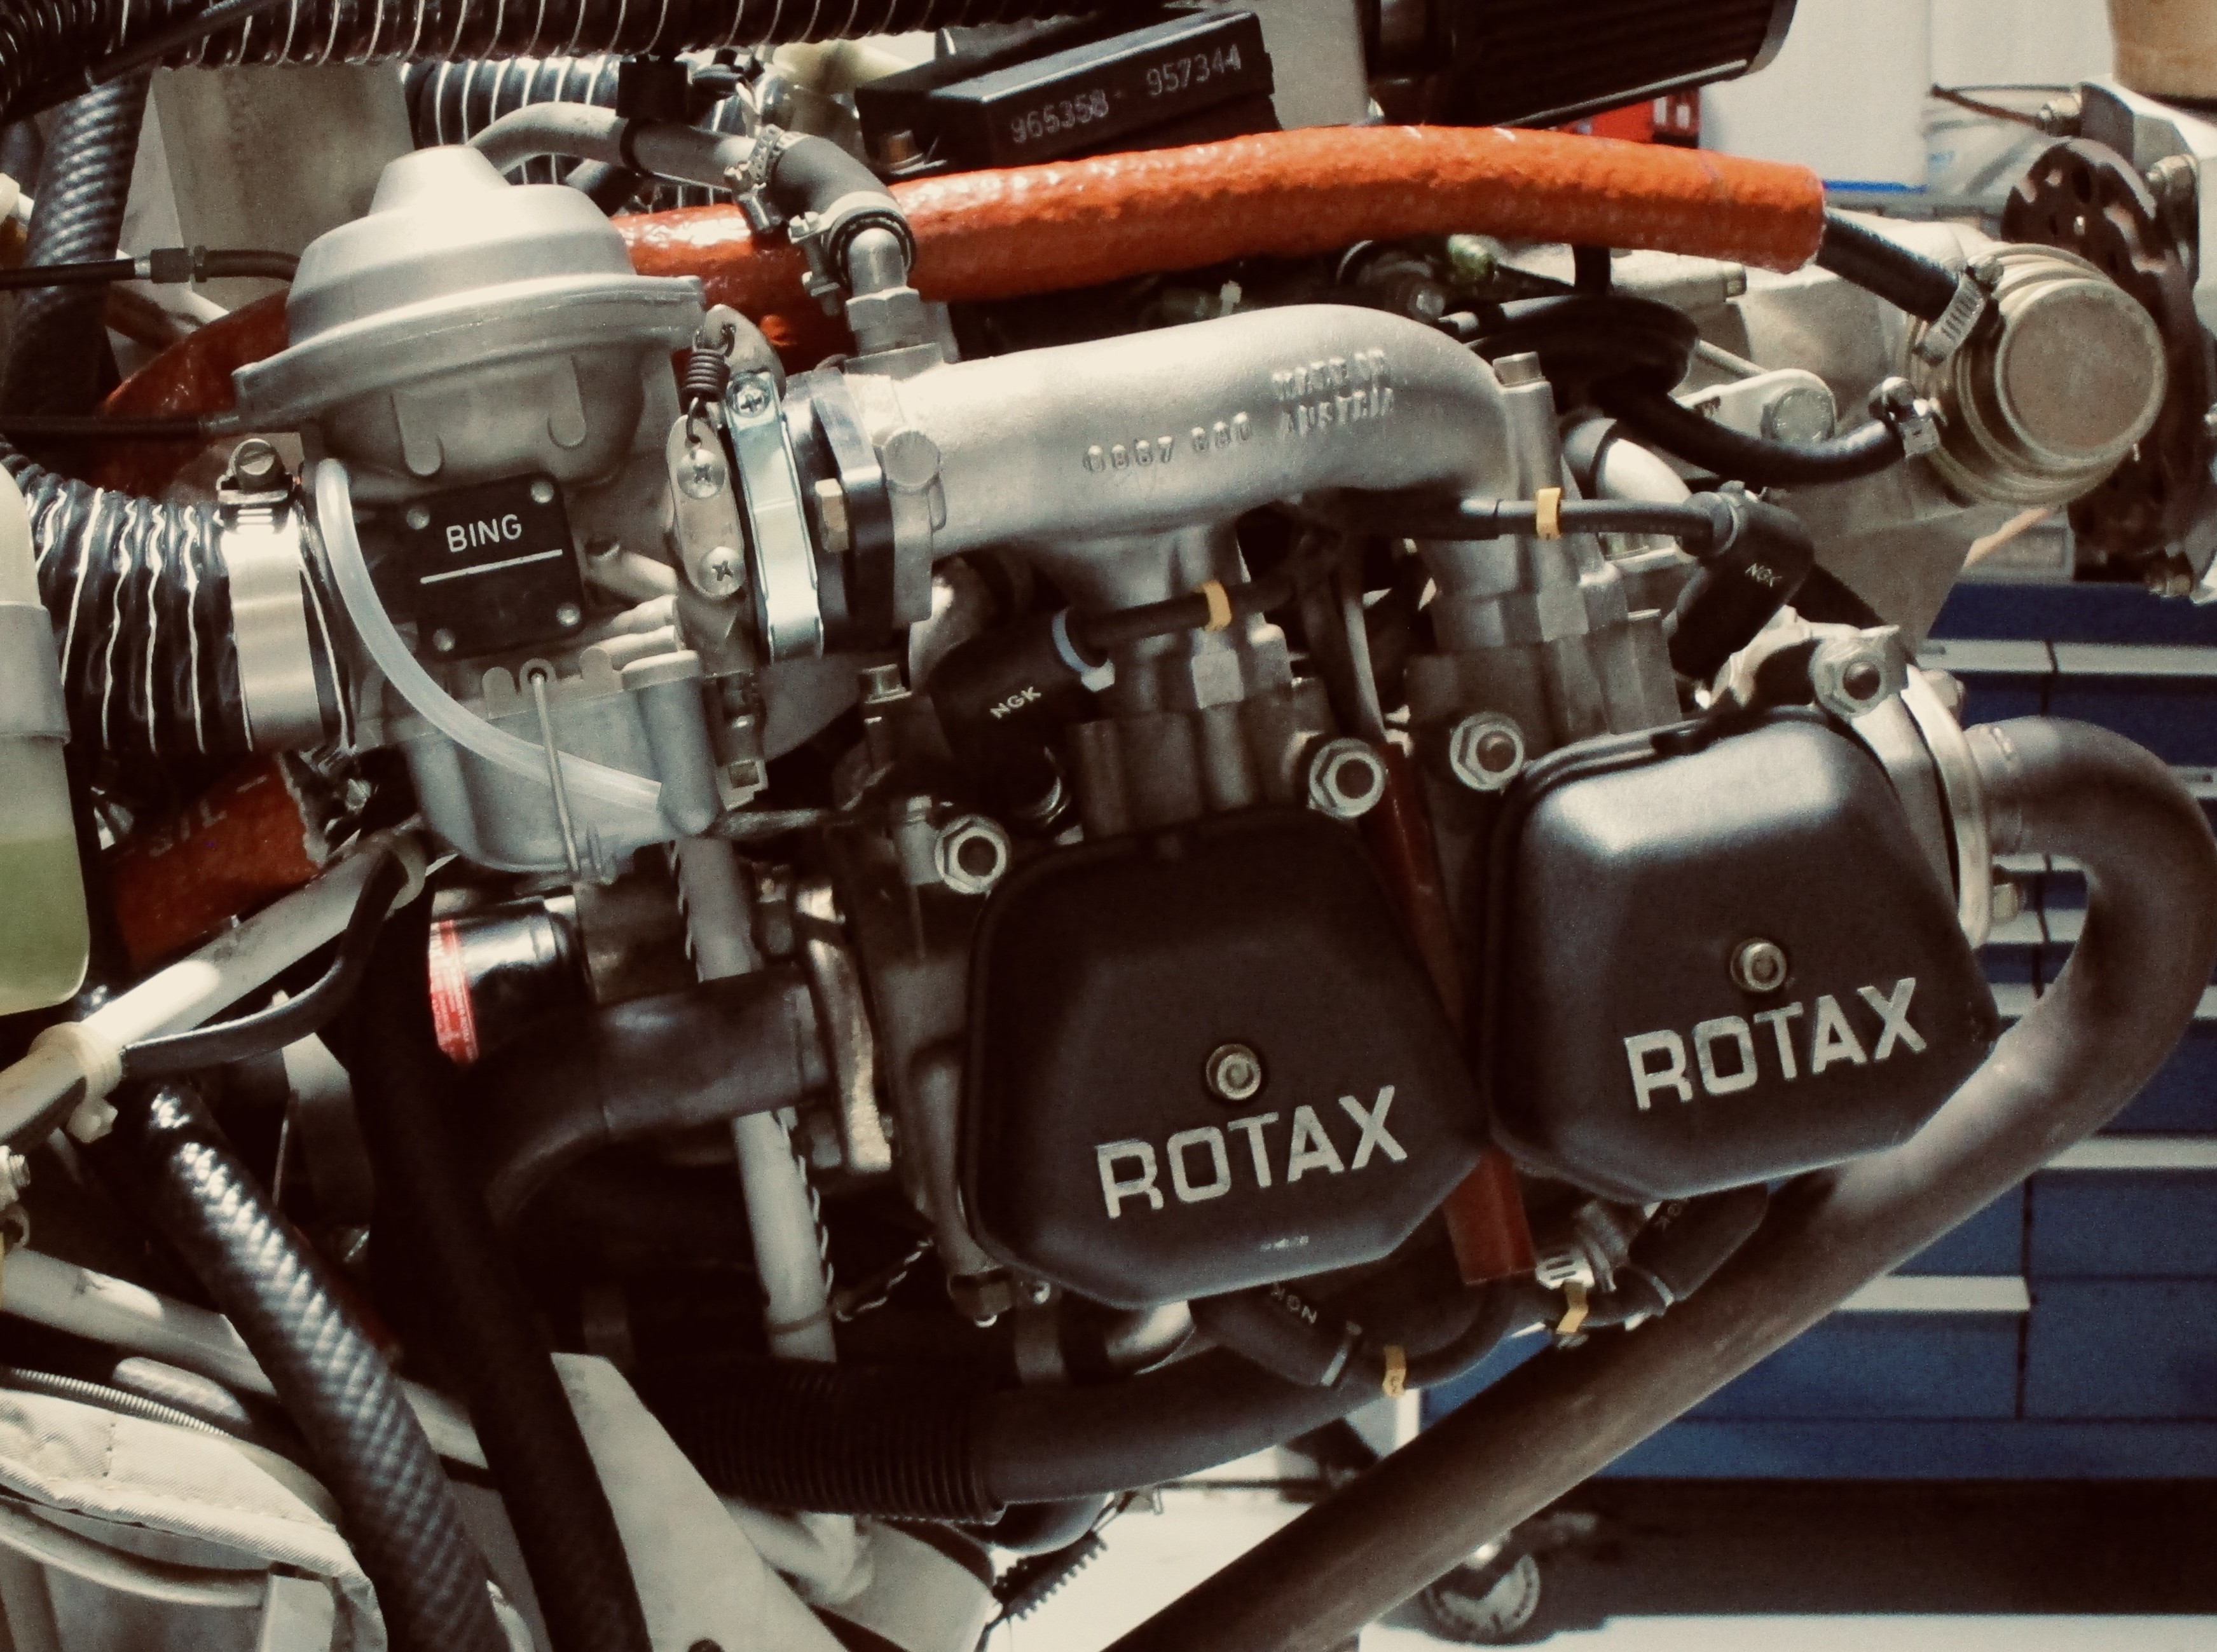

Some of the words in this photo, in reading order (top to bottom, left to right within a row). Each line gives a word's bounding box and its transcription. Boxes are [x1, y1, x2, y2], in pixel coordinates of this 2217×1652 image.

[1146, 43, 1242, 97] 957344
[446, 513, 523, 553] BING
[989, 686, 1042, 719] NGK
[1624, 977, 1928, 1110] ROTAX
[1095, 1084, 1408, 1219] ROTAX
